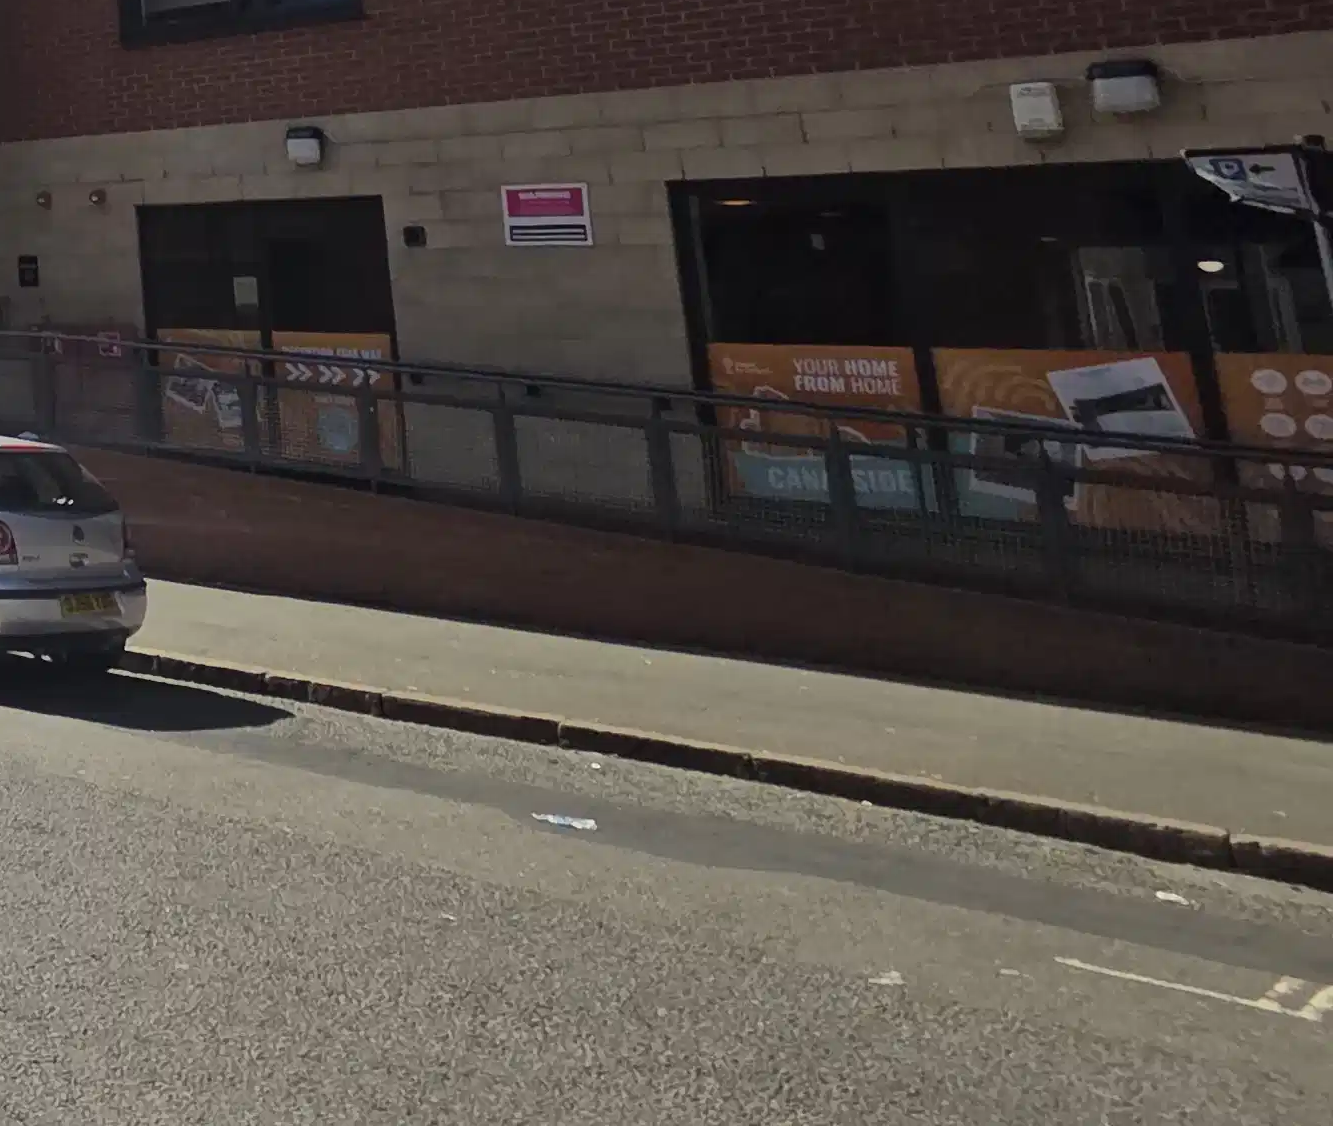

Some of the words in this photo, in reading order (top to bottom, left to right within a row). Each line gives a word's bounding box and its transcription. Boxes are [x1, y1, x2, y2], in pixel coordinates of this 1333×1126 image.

[793, 358, 840, 374] YOUR
[844, 359, 900, 377] HOME
[793, 375, 846, 392] FROM
[850, 377, 902, 396] HOME
[767, 465, 914, 494] CANSIDE
